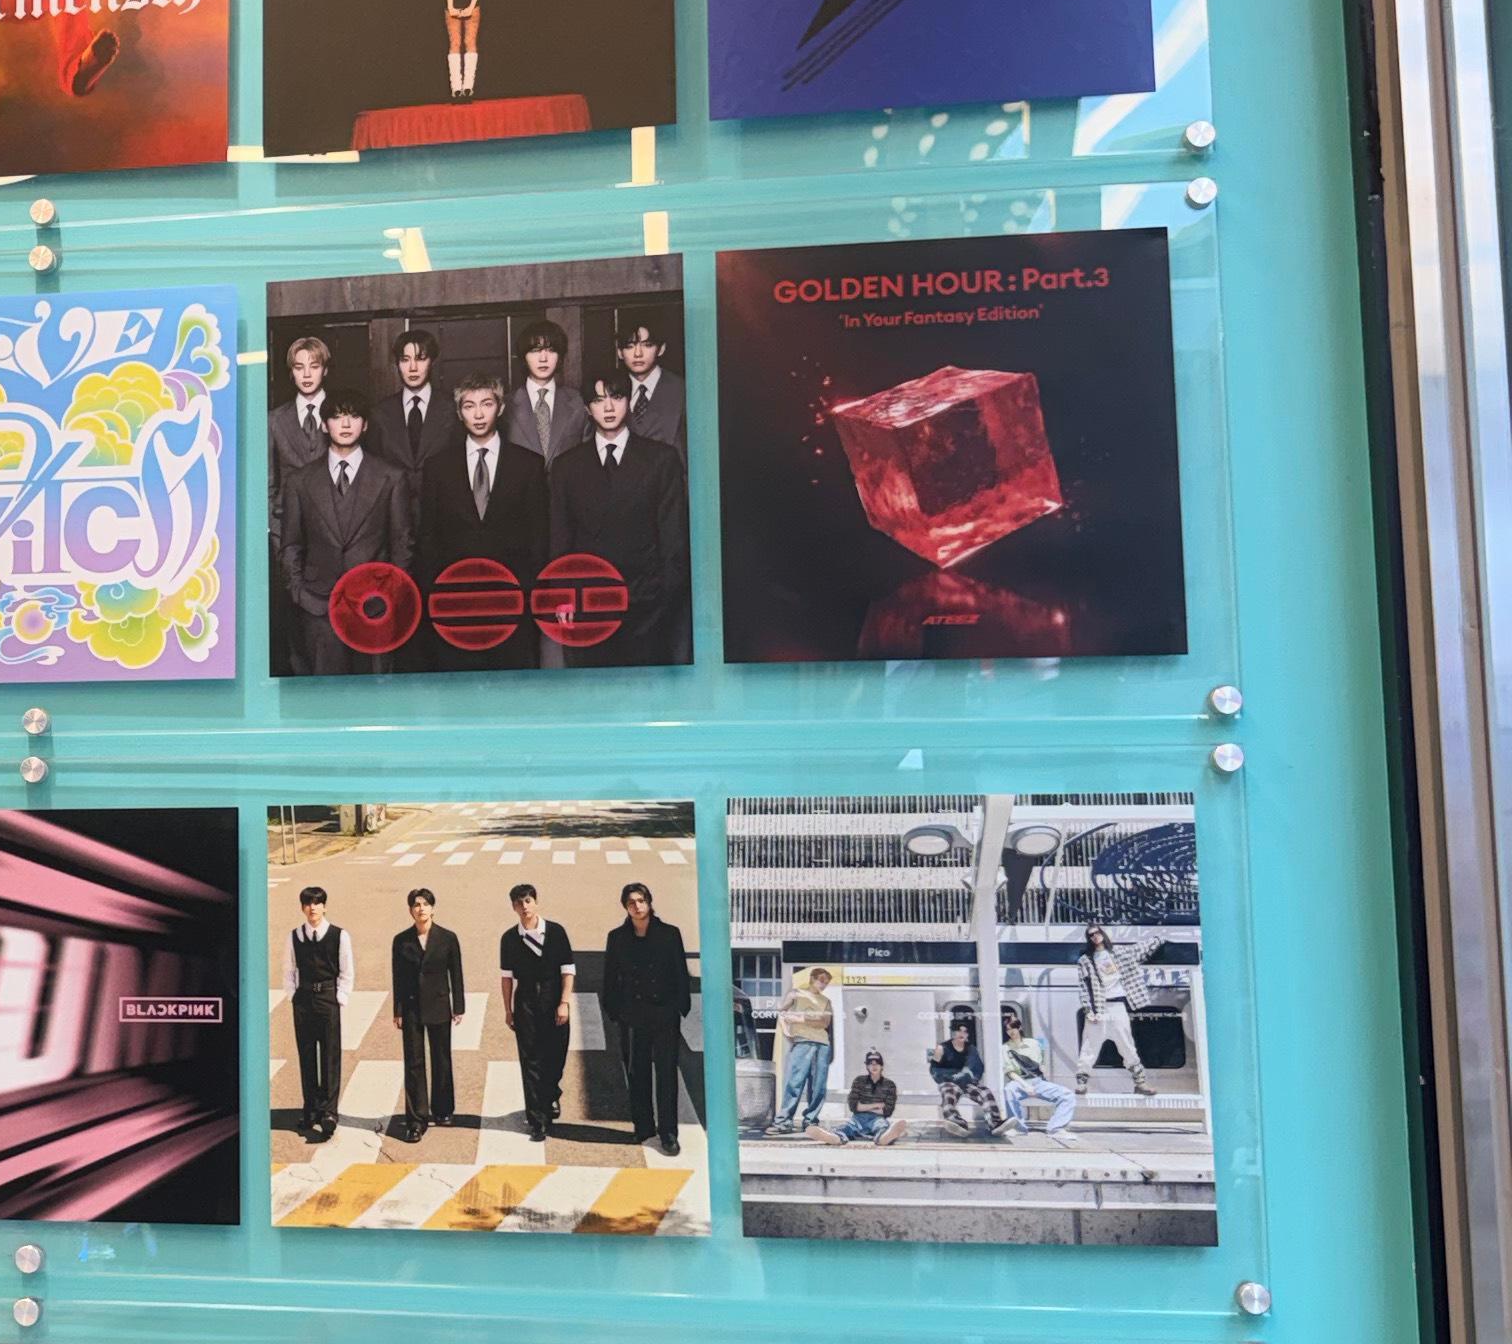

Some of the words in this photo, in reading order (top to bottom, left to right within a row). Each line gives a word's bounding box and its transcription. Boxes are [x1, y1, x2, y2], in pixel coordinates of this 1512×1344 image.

[773, 276, 904, 304] GOLDEN
[911, 270, 1004, 297] HOUR
[1022, 267, 1110, 291] Part.3
[863, 311, 901, 327] Your
[904, 308, 974, 327] Fantasy
[868, 947, 891, 958] Pico
[125, 1003, 216, 1017] BLACKPINK
